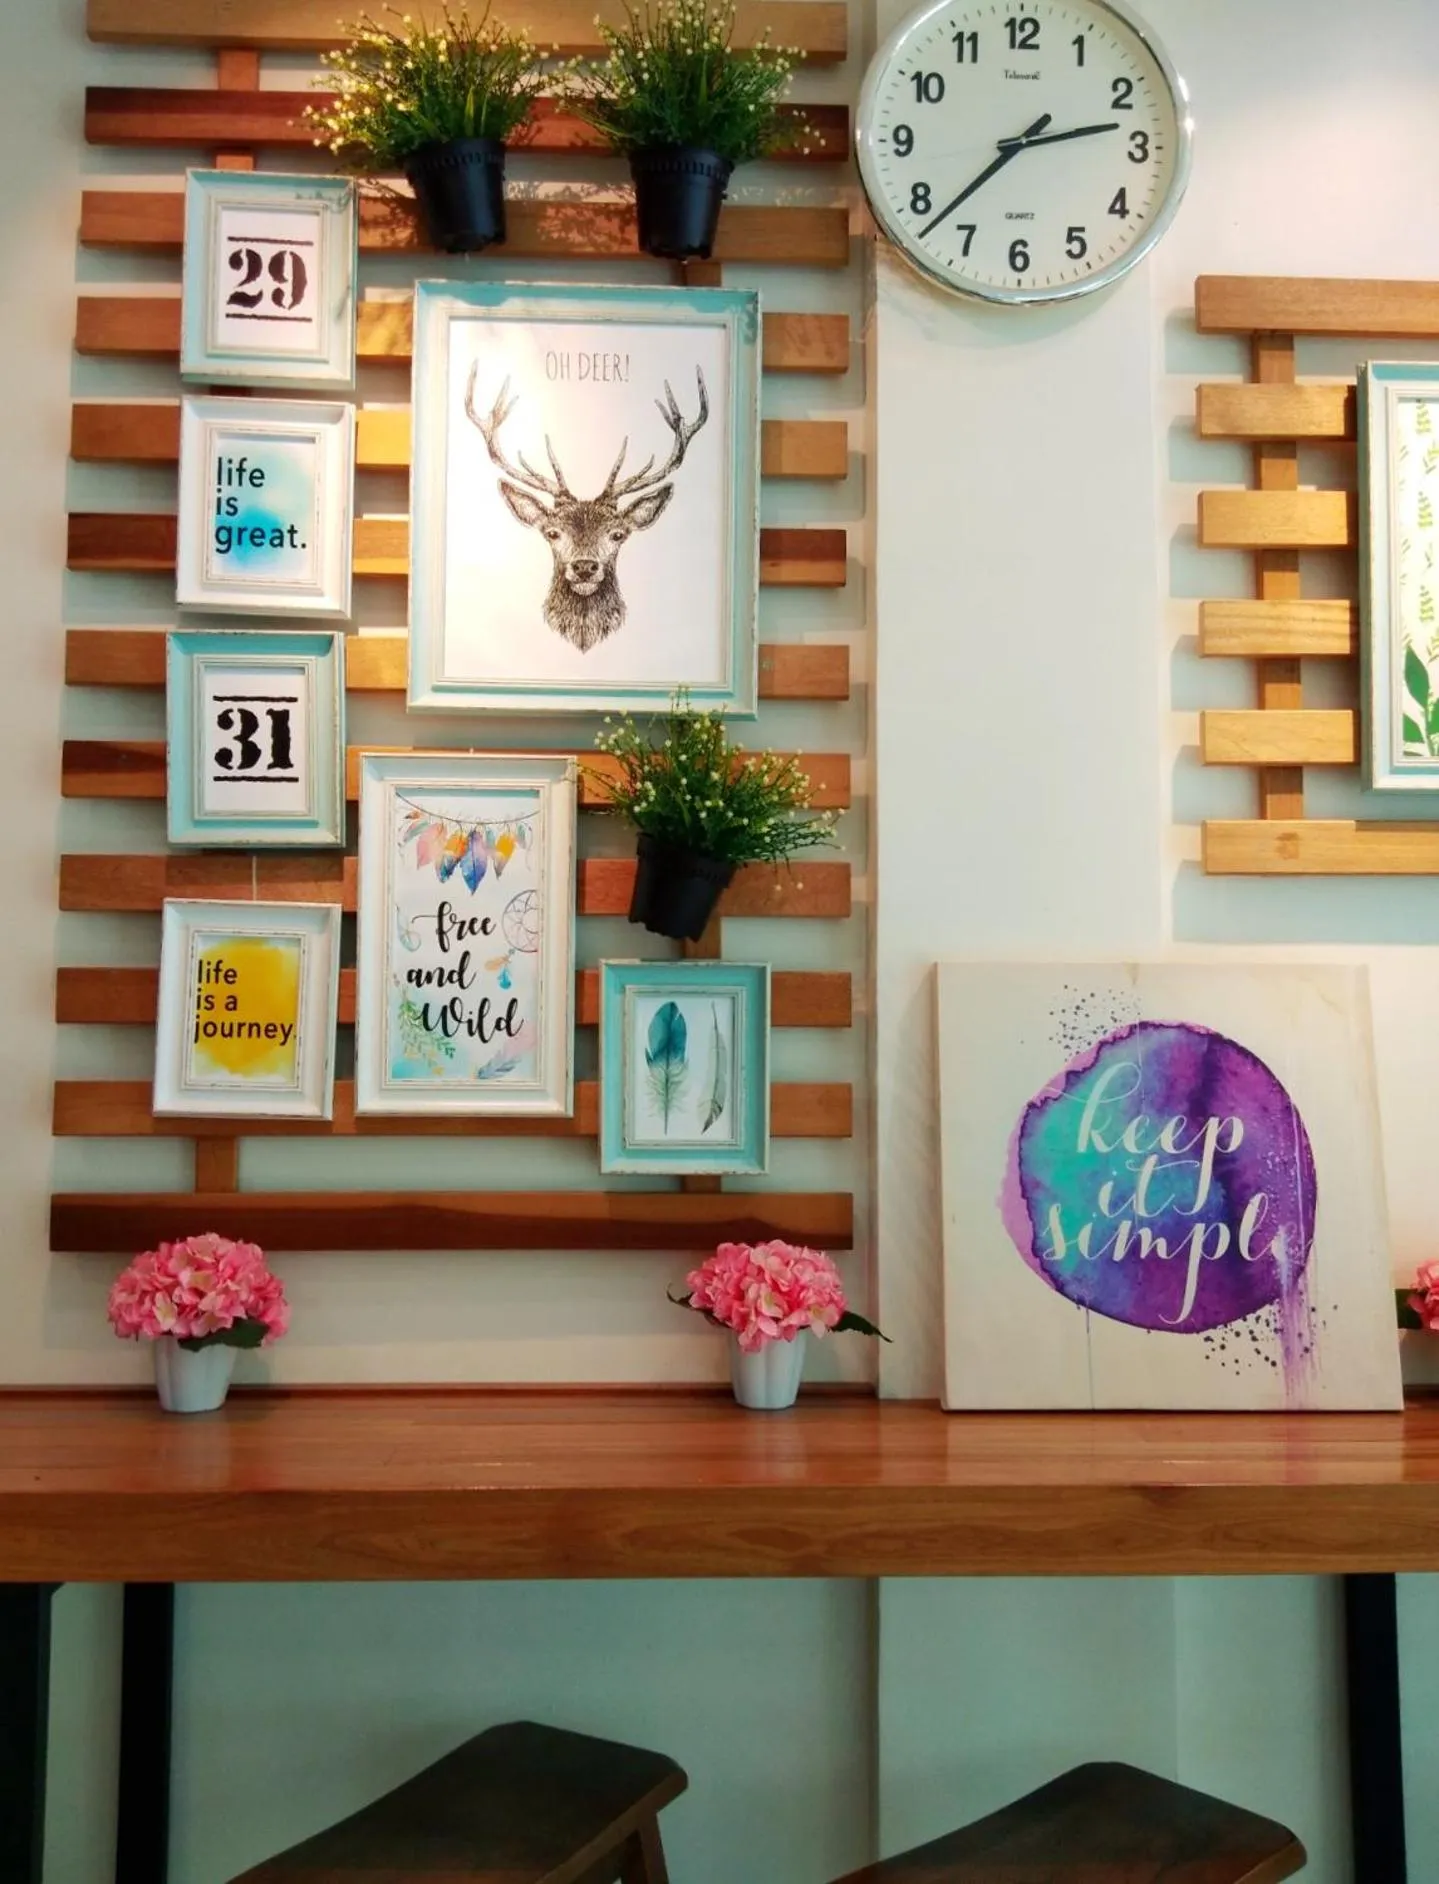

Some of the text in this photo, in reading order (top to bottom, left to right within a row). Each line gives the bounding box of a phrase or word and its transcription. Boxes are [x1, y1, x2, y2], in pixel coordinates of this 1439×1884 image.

[951, 31, 979, 63] 11
[1004, 17, 1040, 50] 12
[1072, 34, 1085, 67] 1
[910, 71, 945, 104] 10
[1111, 77, 1134, 110] 2
[892, 124, 914, 157] 9
[1127, 130, 1149, 164] 3
[910, 182, 932, 215] 8
[1108, 187, 1130, 219] 4
[956, 224, 977, 257] 7
[1008, 239, 1030, 273] 6
[1065, 227, 1087, 259] 5
[227, 248, 308, 311] 29
[546, 351, 630, 383] OH DEER!
[217, 456, 266, 488] life
[216, 487, 239, 517] is
[215, 523, 307, 554] great.
[214, 708, 294, 770] 31
[411, 901, 496, 953] free
[197, 959, 238, 985] life
[406, 950, 477, 990] and
[196, 987, 238, 1011] is a
[413, 997, 524, 1044] Wild
[1046, 1062, 1244, 1216] keep
[1099, 1154, 1200, 1219] it
